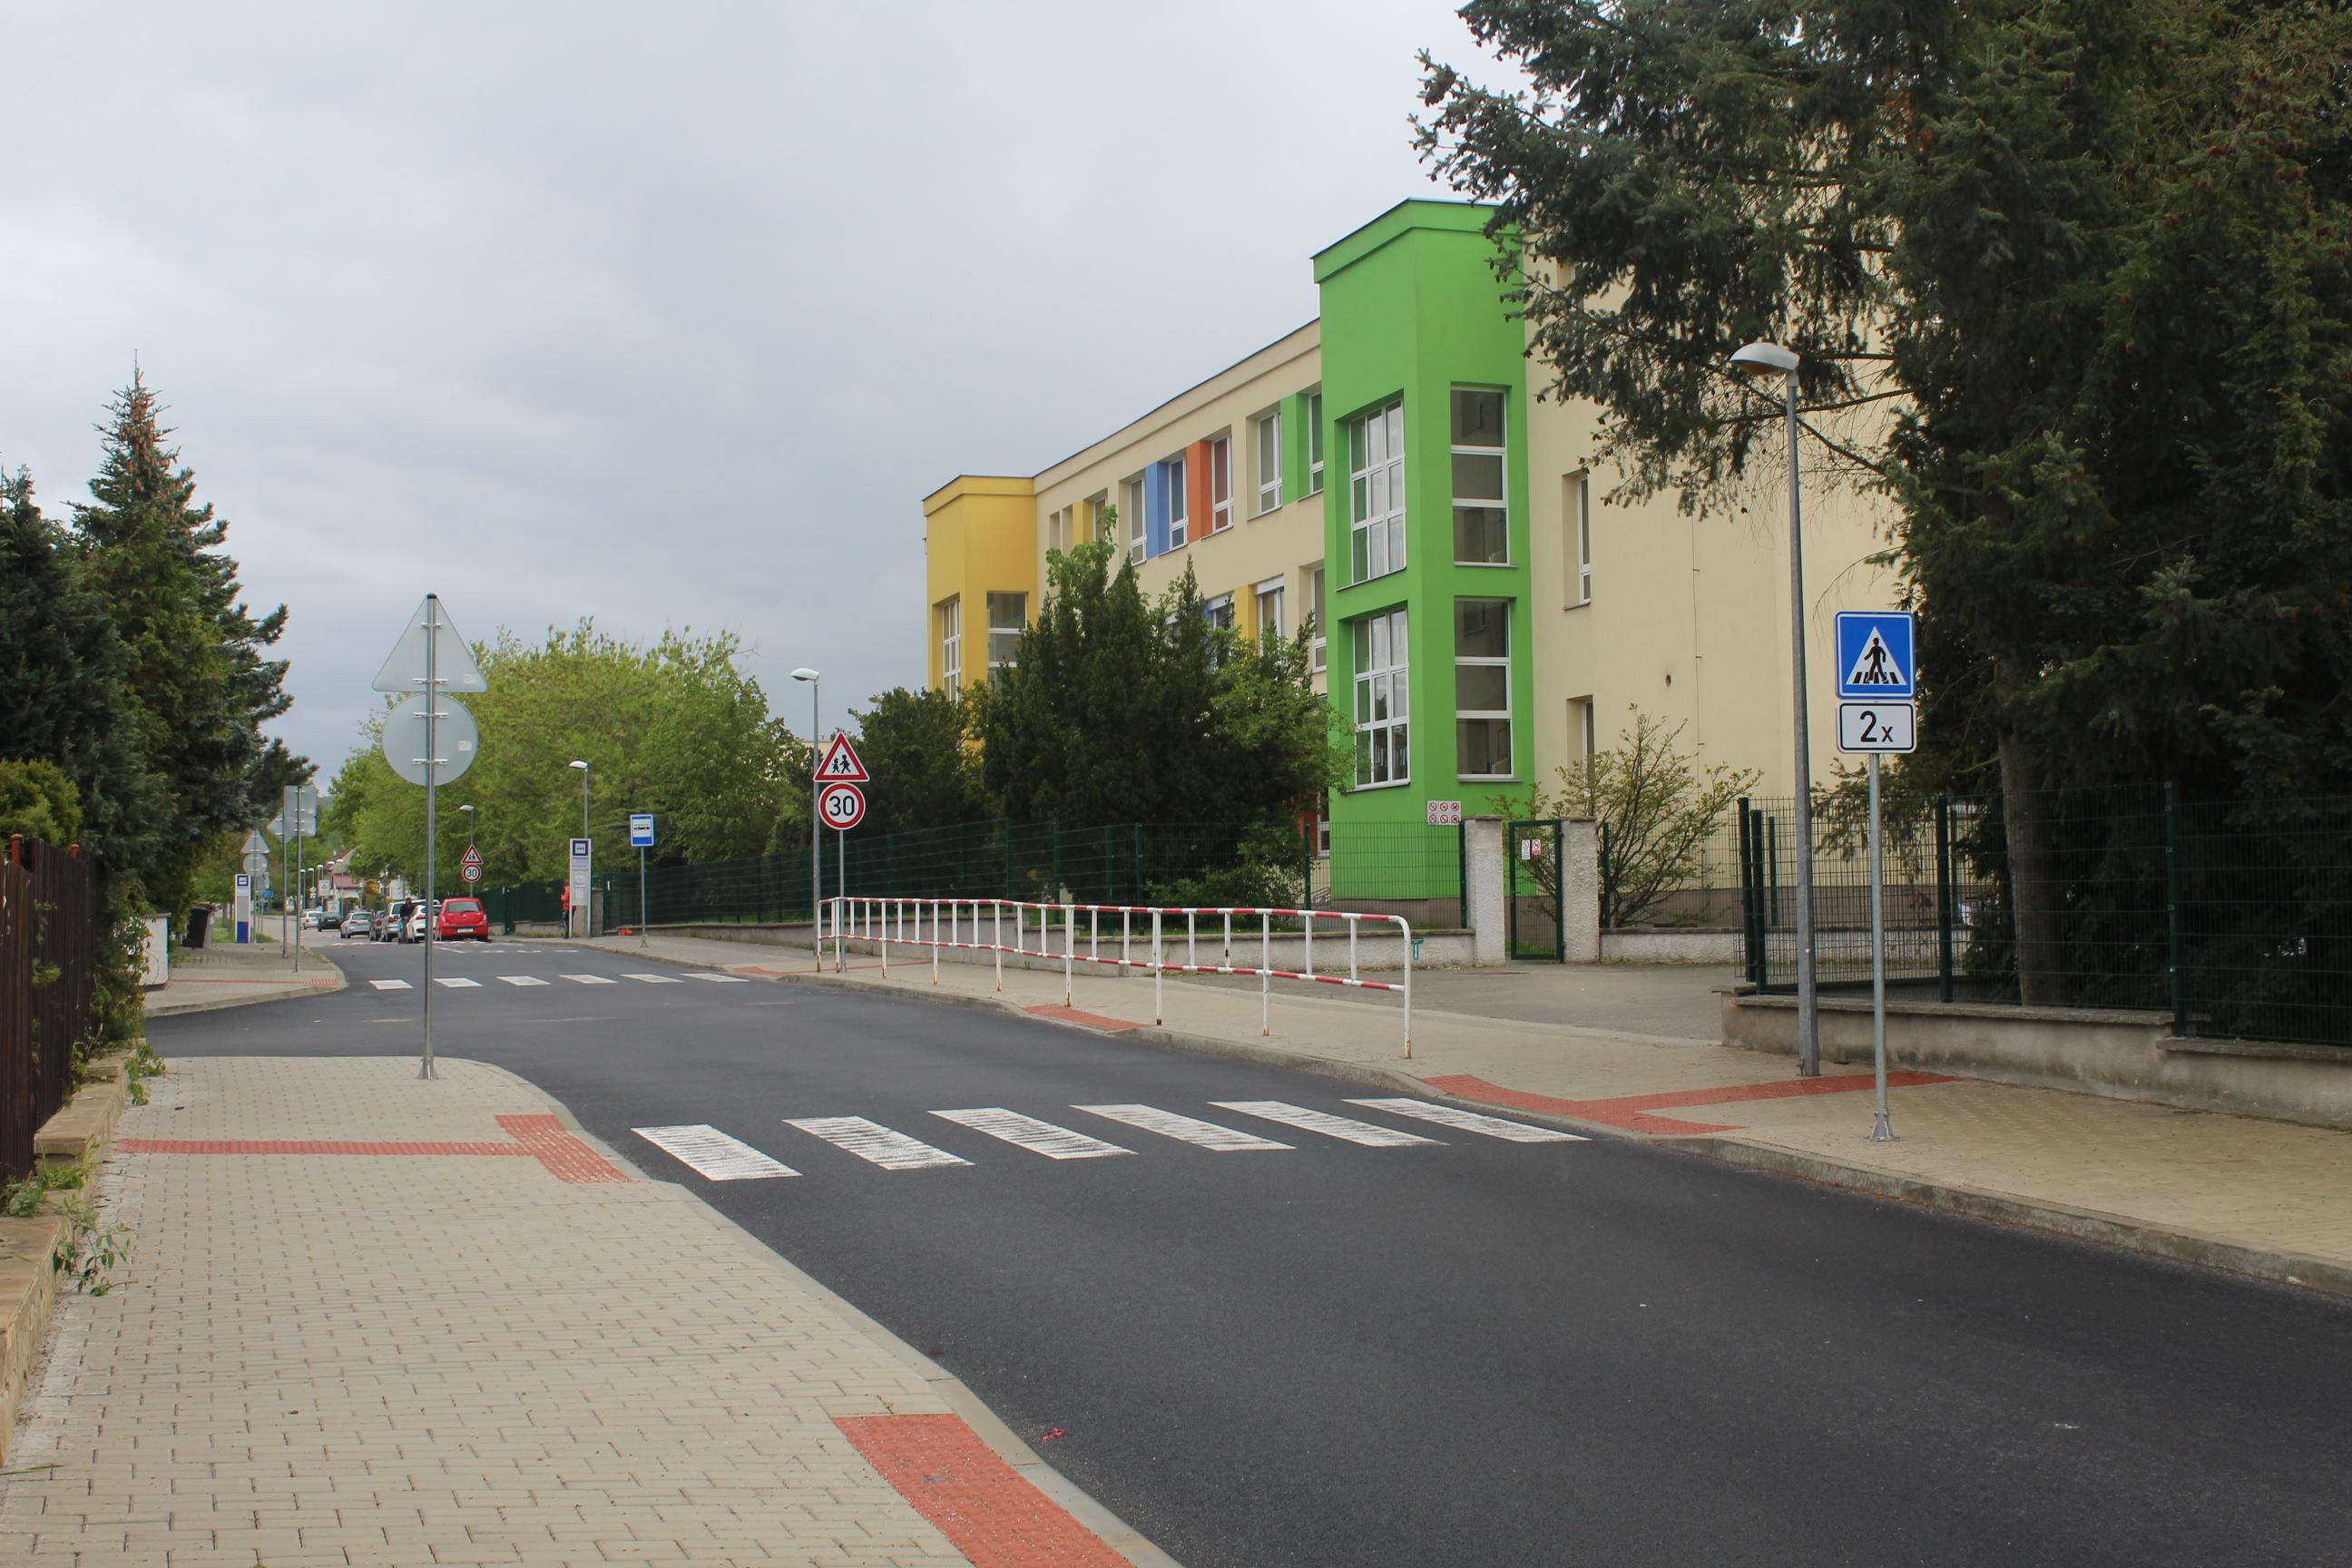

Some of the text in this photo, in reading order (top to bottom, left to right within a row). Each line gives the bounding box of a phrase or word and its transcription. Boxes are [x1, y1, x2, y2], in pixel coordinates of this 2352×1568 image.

[1860, 710, 1894, 742] 2x
[829, 796, 855, 816] 30
[467, 868, 477, 877] 30
